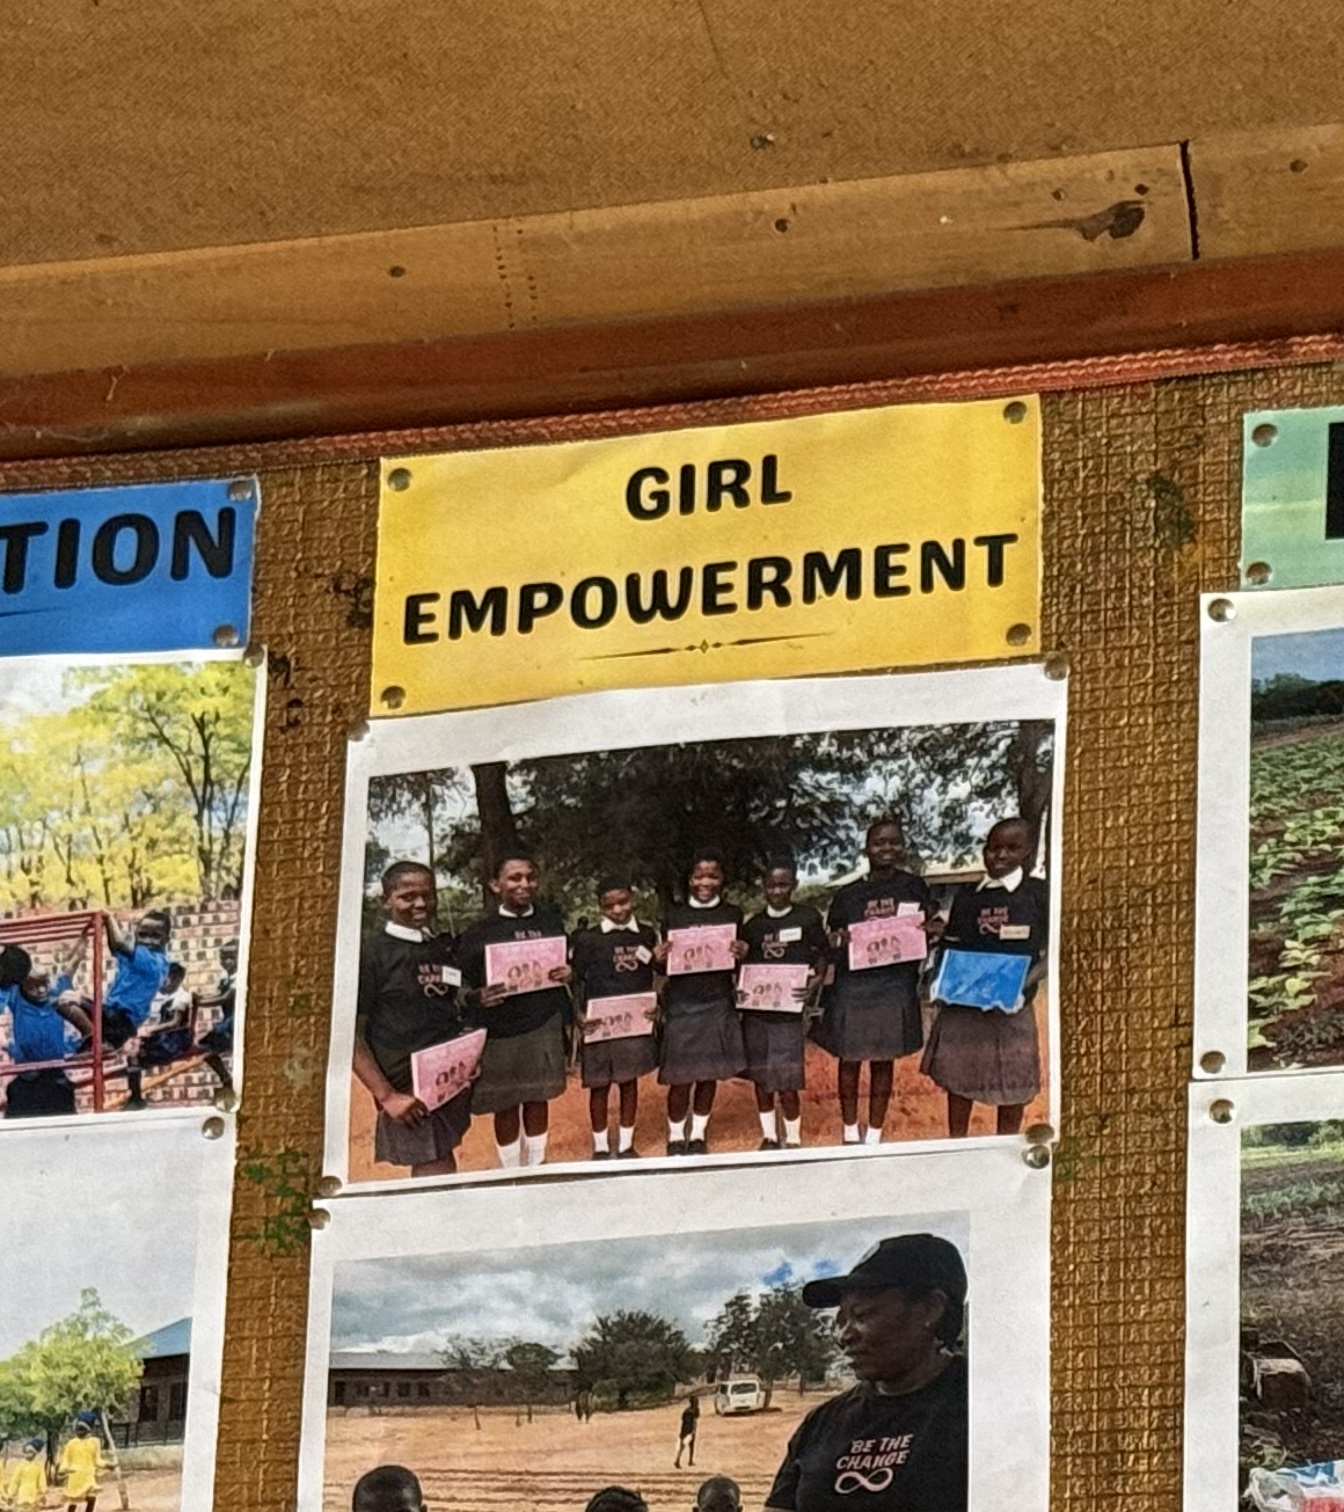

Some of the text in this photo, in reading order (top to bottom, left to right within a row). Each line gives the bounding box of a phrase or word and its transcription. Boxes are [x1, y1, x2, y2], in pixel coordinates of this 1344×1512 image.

[625, 454, 792, 521] GIRL
[403, 533, 1019, 646] EMPOWERMENT
[836, 1450, 911, 1470] CHANGE
[850, 1433, 914, 1454] BE THE
